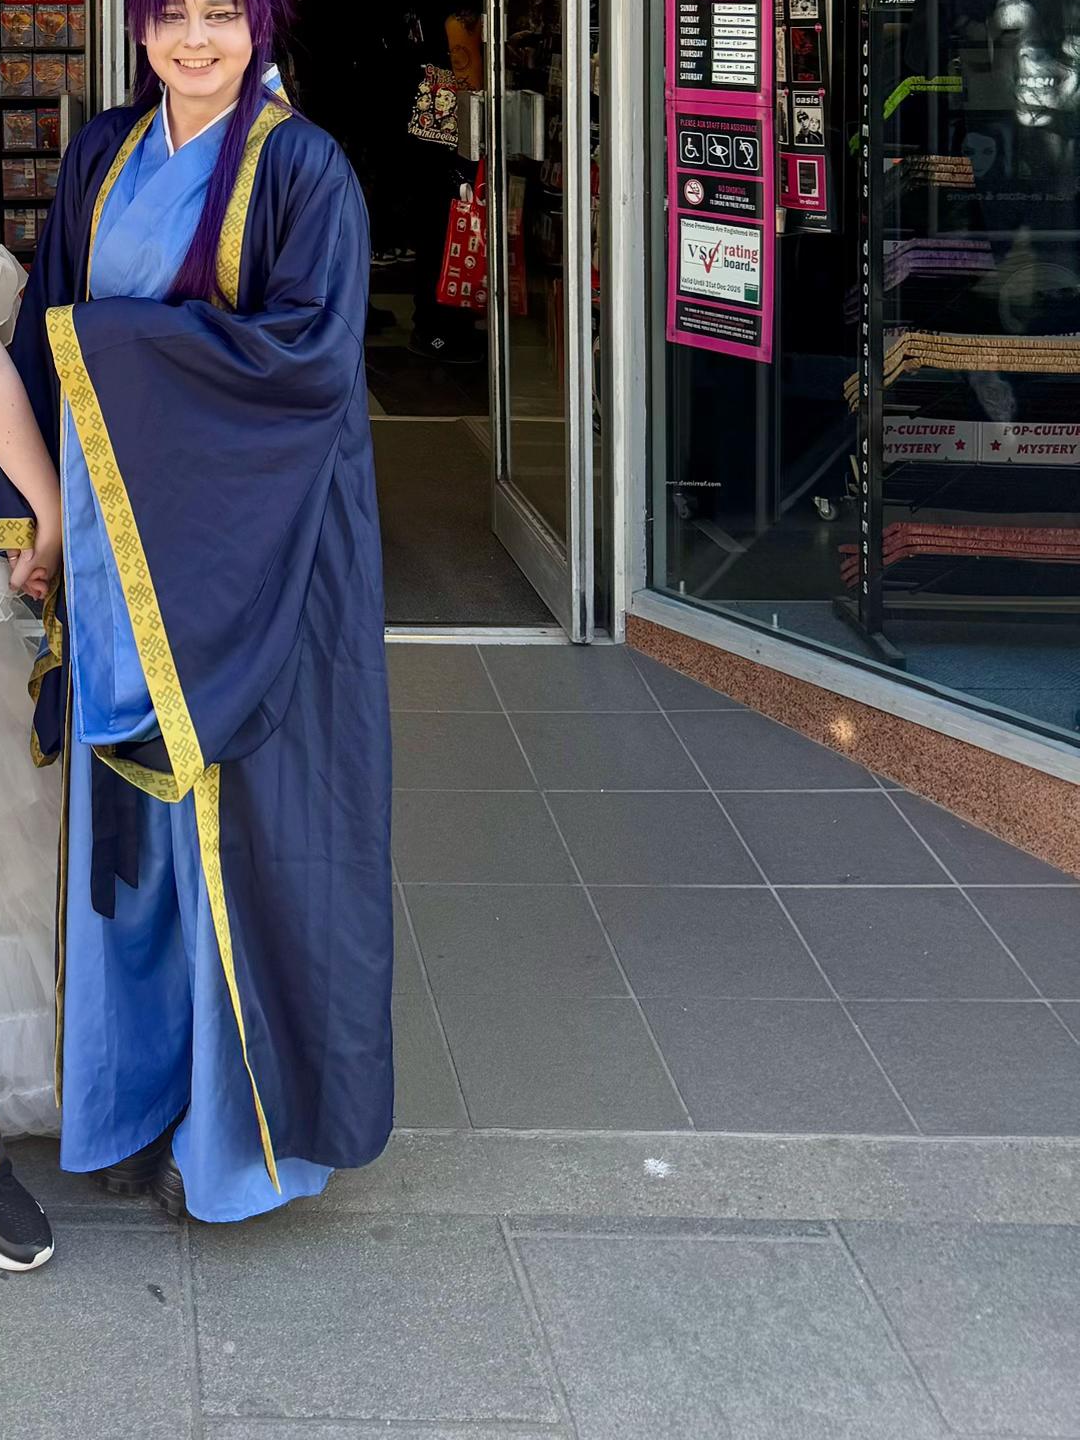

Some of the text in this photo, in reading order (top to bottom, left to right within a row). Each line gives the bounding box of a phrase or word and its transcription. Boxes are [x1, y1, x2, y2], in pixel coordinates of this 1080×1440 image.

[796, 96, 819, 104] oasis
[724, 244, 758, 263] rating
[884, 424, 956, 435] P-CULTURE
[1004, 426, 1080, 436] POP-CULTUR
[883, 443, 941, 454] MYSTERY
[1017, 444, 1077, 454] MYSTERY
